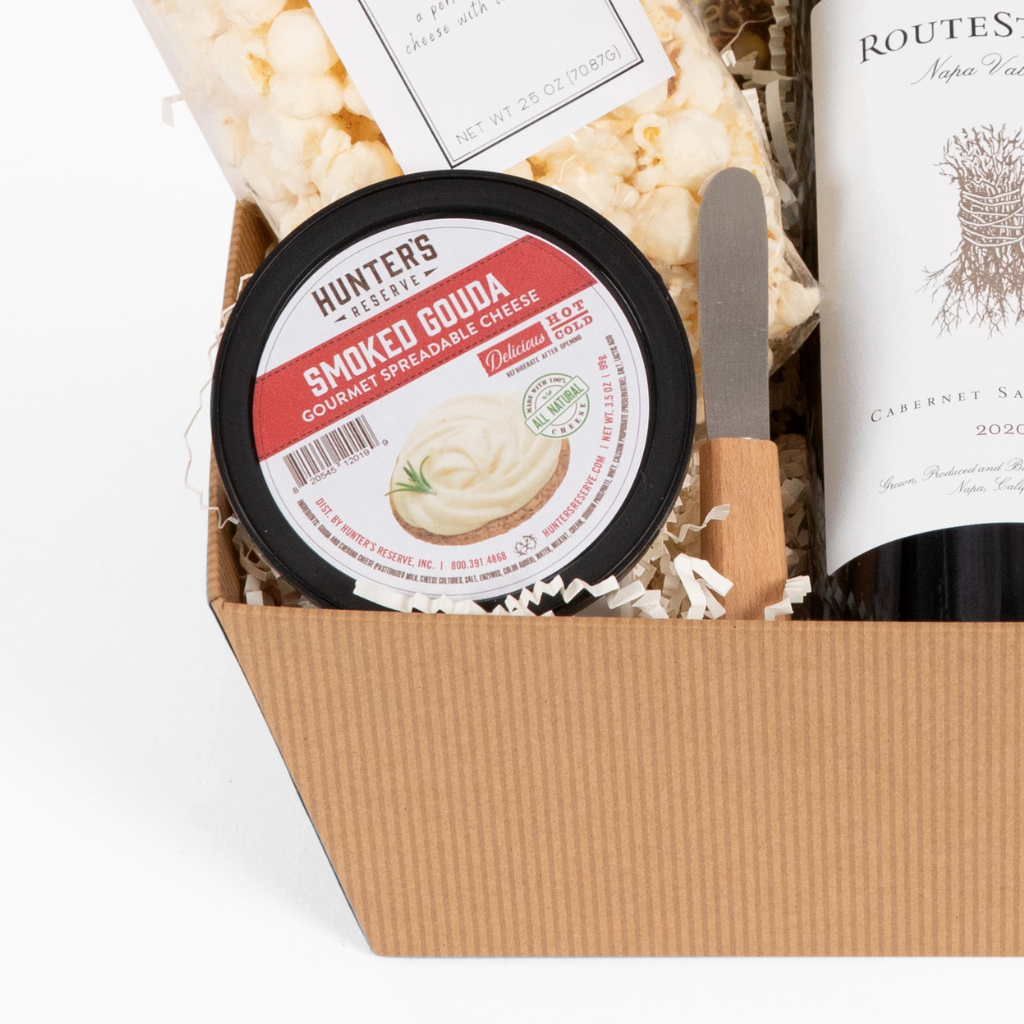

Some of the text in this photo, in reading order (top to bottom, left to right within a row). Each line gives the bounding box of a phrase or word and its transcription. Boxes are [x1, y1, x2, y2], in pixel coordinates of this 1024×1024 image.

[405, 22, 451, 55] cheese
[456, 0, 488, 27] with
[416, 13, 423, 22] a
[911, 56, 978, 85] Napa
[456, 121, 483, 144] NET
[490, 106, 512, 125] WT
[543, 78, 564, 95] OZ
[312, 234, 438, 317] HUNTER'S
[351, 274, 421, 317] RESERVE
[545, 299, 584, 326] HOT
[303, 273, 510, 398] SMOKED GOUDA
[554, 315, 593, 340] COLD
[302, 289, 540, 422] GOURMET SPREADABLE CHEESE
[486, 333, 545, 372] Delicious
[542, 348, 558, 359] AFTER
[560, 334, 582, 349] OPENING
[598, 355, 608, 370] 99g
[531, 380, 547, 394] WITH
[603, 382, 612, 392] OZ
[532, 383, 584, 429] ALL NATURAL
[605, 395, 614, 407] 3.5
[552, 402, 586, 435] CHEESE
[604, 410, 614, 424] WT.
[602, 426, 612, 441] NET
[310, 467, 337, 485] 20545
[344, 449, 370, 466] 12019
[879, 476, 917, 493] Grown,
[922, 464, 977, 481] Produced
[978, 462, 1003, 472] and
[542, 455, 606, 537] HUNTERSRESERVE.COM
[948, 479, 987, 495] Napa,
[315, 498, 332, 518] DIST.
[331, 515, 343, 527] BY
[340, 524, 377, 551] HUNTER'S
[377, 546, 414, 568] RESERVE,
[418, 559, 435, 569] INC.
[451, 551, 507, 570] 800.391.4868
